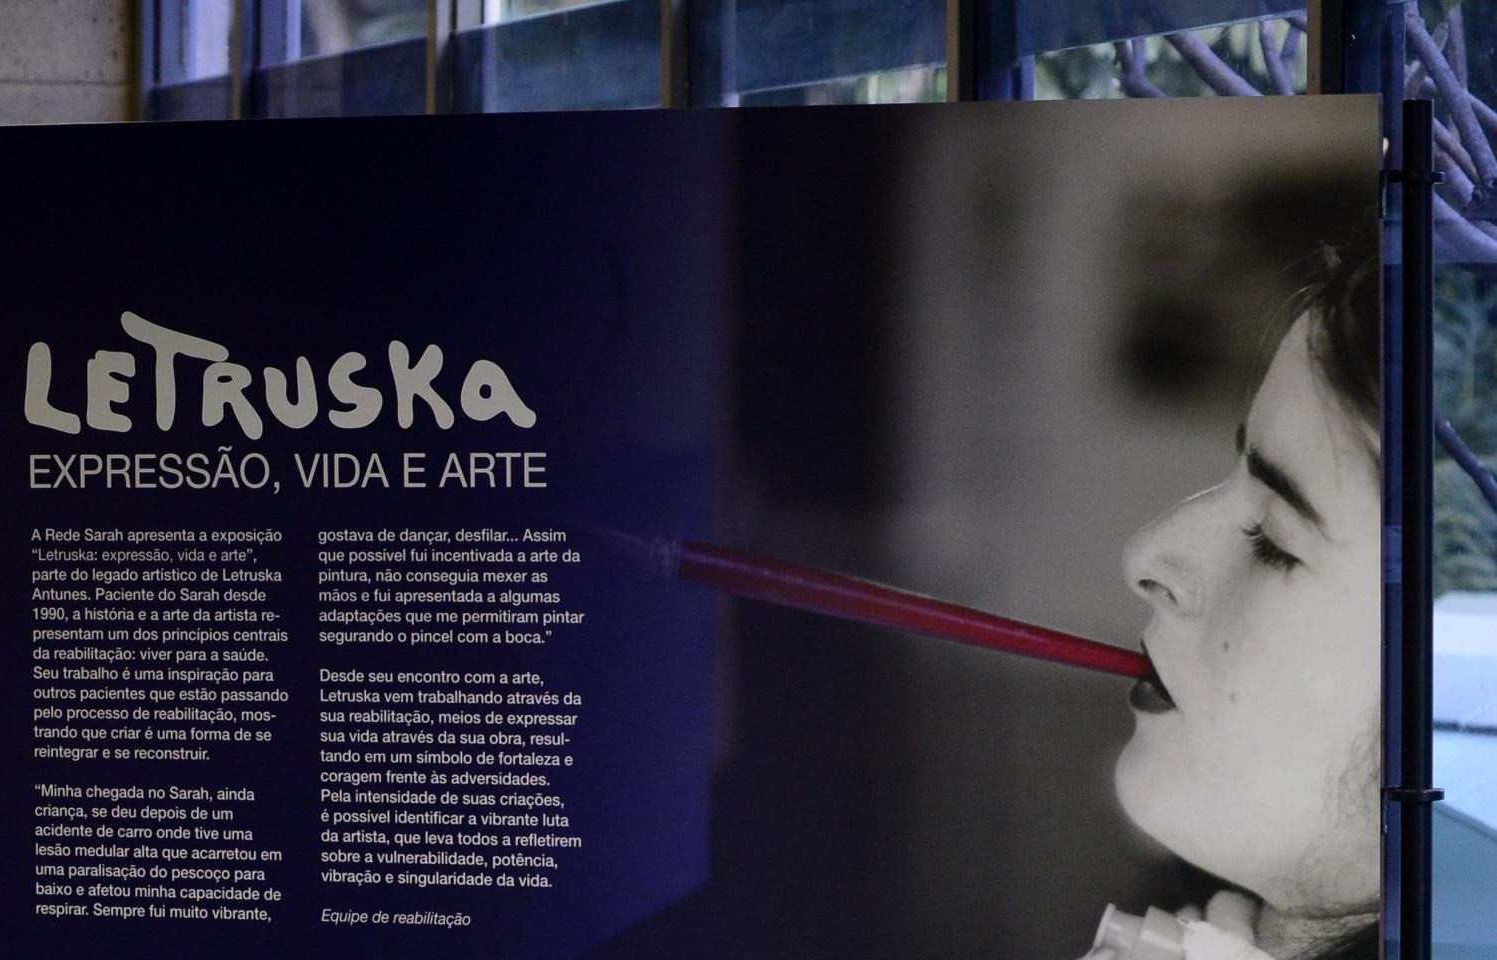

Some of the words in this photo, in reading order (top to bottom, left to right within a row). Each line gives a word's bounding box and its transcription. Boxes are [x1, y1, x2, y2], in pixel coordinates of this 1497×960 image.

[24, 311, 536, 440] LETRUSKA
[29, 446, 280, 494] EXPRESSÃO,
[293, 452, 390, 489] VIDA
[403, 452, 427, 488] E
[438, 451, 548, 488] ARTE
[30, 528, 42, 540] A
[45, 528, 80, 541] Rede
[83, 528, 124, 541] Sarah
[126, 529, 195, 544] apresenta
[198, 531, 208, 541] a
[210, 528, 282, 544] exposição
[317, 528, 374, 544] gostava
[376, 528, 396, 541] de
[398, 528, 451, 545] dançar,
[522, 528, 566, 542] Assim
[101, 548, 173, 564] expressão,
[176, 548, 205, 561] vida
[208, 551, 217, 561] e
[31, 568, 67, 583] parte
[70, 567, 88, 580] do
[92, 567, 138, 584] legado
[141, 568, 197, 581] artístico
[200, 568, 218, 581] de
[222, 568, 282, 581] Letruska
[318, 568, 371, 584] pintura,
[375, 568, 402, 582] não
[405, 568, 480, 585] conseguia
[482, 572, 528, 582] mexer
[530, 572, 548, 582] as
[31, 587, 91, 600] Antunes.
[94, 587, 154, 600] Paciente
[158, 587, 176, 600] do
[179, 587, 220, 601] Sarah
[222, 588, 266, 601] desde
[318, 588, 357, 601] mãos
[360, 591, 370, 601] e
[373, 588, 391, 601] fui
[394, 589, 484, 605] apresentada
[486, 592, 496, 602] a
[498, 589, 560, 606] algumas
[318, 609, 402, 625] adaptações
[404, 612, 432, 625] que
[435, 612, 458, 622] me
[461, 609, 538, 626] permitiram
[542, 609, 586, 626] pintar
[32, 627, 104, 642] presentam
[107, 630, 129, 640] um
[132, 627, 158, 640] dos
[162, 627, 230, 644] princípios
[232, 628, 288, 641] centrais
[32, 646, 50, 659] da
[53, 646, 136, 663] reabilitação:
[139, 647, 173, 660] viver
[175, 650, 207, 663] para
[209, 650, 219, 661] a
[222, 647, 268, 661] saúde.
[319, 668, 364, 682] Desde
[367, 672, 394, 682] seu
[396, 670, 460, 683] encontro
[463, 672, 496, 683] com
[498, 673, 509, 684] a
[511, 671, 544, 686] arte,
[32, 686, 76, 699] outros
[79, 686, 146, 702] pacientes
[148, 689, 176, 703] que
[178, 687, 218, 700] estão
[220, 687, 289, 704] passando
[319, 688, 380, 702] Letruska
[384, 692, 414, 702] vem
[416, 689, 503, 704] trabalhando
[506, 690, 560, 704] através
[562, 691, 582, 705] da
[33, 705, 63, 721] pelo
[66, 708, 129, 722] processo
[132, 706, 150, 719] de
[153, 706, 237, 724] reabilitação,
[240, 710, 276, 721] mos-
[319, 711, 346, 722] sua
[348, 708, 434, 726] reabilitação,
[438, 710, 482, 724] meios
[484, 710, 504, 724] de
[506, 713, 578, 728] expressar
[33, 744, 99, 761] reintegrar
[101, 748, 111, 758] e
[114, 748, 130, 759] se
[134, 746, 210, 760] reconstruir.
[320, 771, 382, 786] coragem
[384, 769, 427, 784] frente
[430, 770, 447, 784] às
[450, 770, 550, 786] adversidades.
[85, 784, 144, 801] chegada
[148, 788, 166, 799] no
[168, 786, 213, 802] Sarah,
[216, 787, 255, 800] ainda
[320, 788, 352, 802] Pela
[354, 789, 437, 804] intensidade
[439, 791, 459, 804] de
[461, 794, 496, 805] suas
[499, 791, 564, 810] criações,
[34, 823, 93, 837] acidente
[96, 824, 114, 837] de
[116, 827, 153, 838] carro
[155, 825, 191, 839] onde
[193, 826, 219, 839] tive
[222, 830, 253, 840] uma
[34, 842, 71, 856] lesão
[74, 843, 130, 857] medular
[132, 844, 158, 858] alta
[160, 848, 188, 861] que
[190, 846, 257, 860] acarretou
[260, 850, 282, 861] em
[320, 848, 361, 863] sobre
[363, 852, 374, 863] a
[376, 849, 488, 868] vulnerabilidade,
[492, 851, 558, 870] potência,
[35, 865, 65, 875] uma
[68, 863, 146, 881] paralisação
[149, 864, 168, 878] do
[170, 868, 230, 883] pescoço
[233, 869, 266, 883] para
[320, 868, 381, 887] vibração
[384, 873, 394, 883] e
[397, 870, 493, 889] singularidade
[495, 872, 515, 886] da
[517, 873, 553, 887] vida.
[35, 901, 89, 918] respirar.
[92, 902, 146, 919] Sempre
[148, 904, 166, 917] fui
[169, 904, 208, 918] muito
[211, 905, 272, 922] vibrante,
[320, 908, 368, 926] Equipe
[370, 910, 390, 923] de
[392, 910, 472, 929] reabilitação
